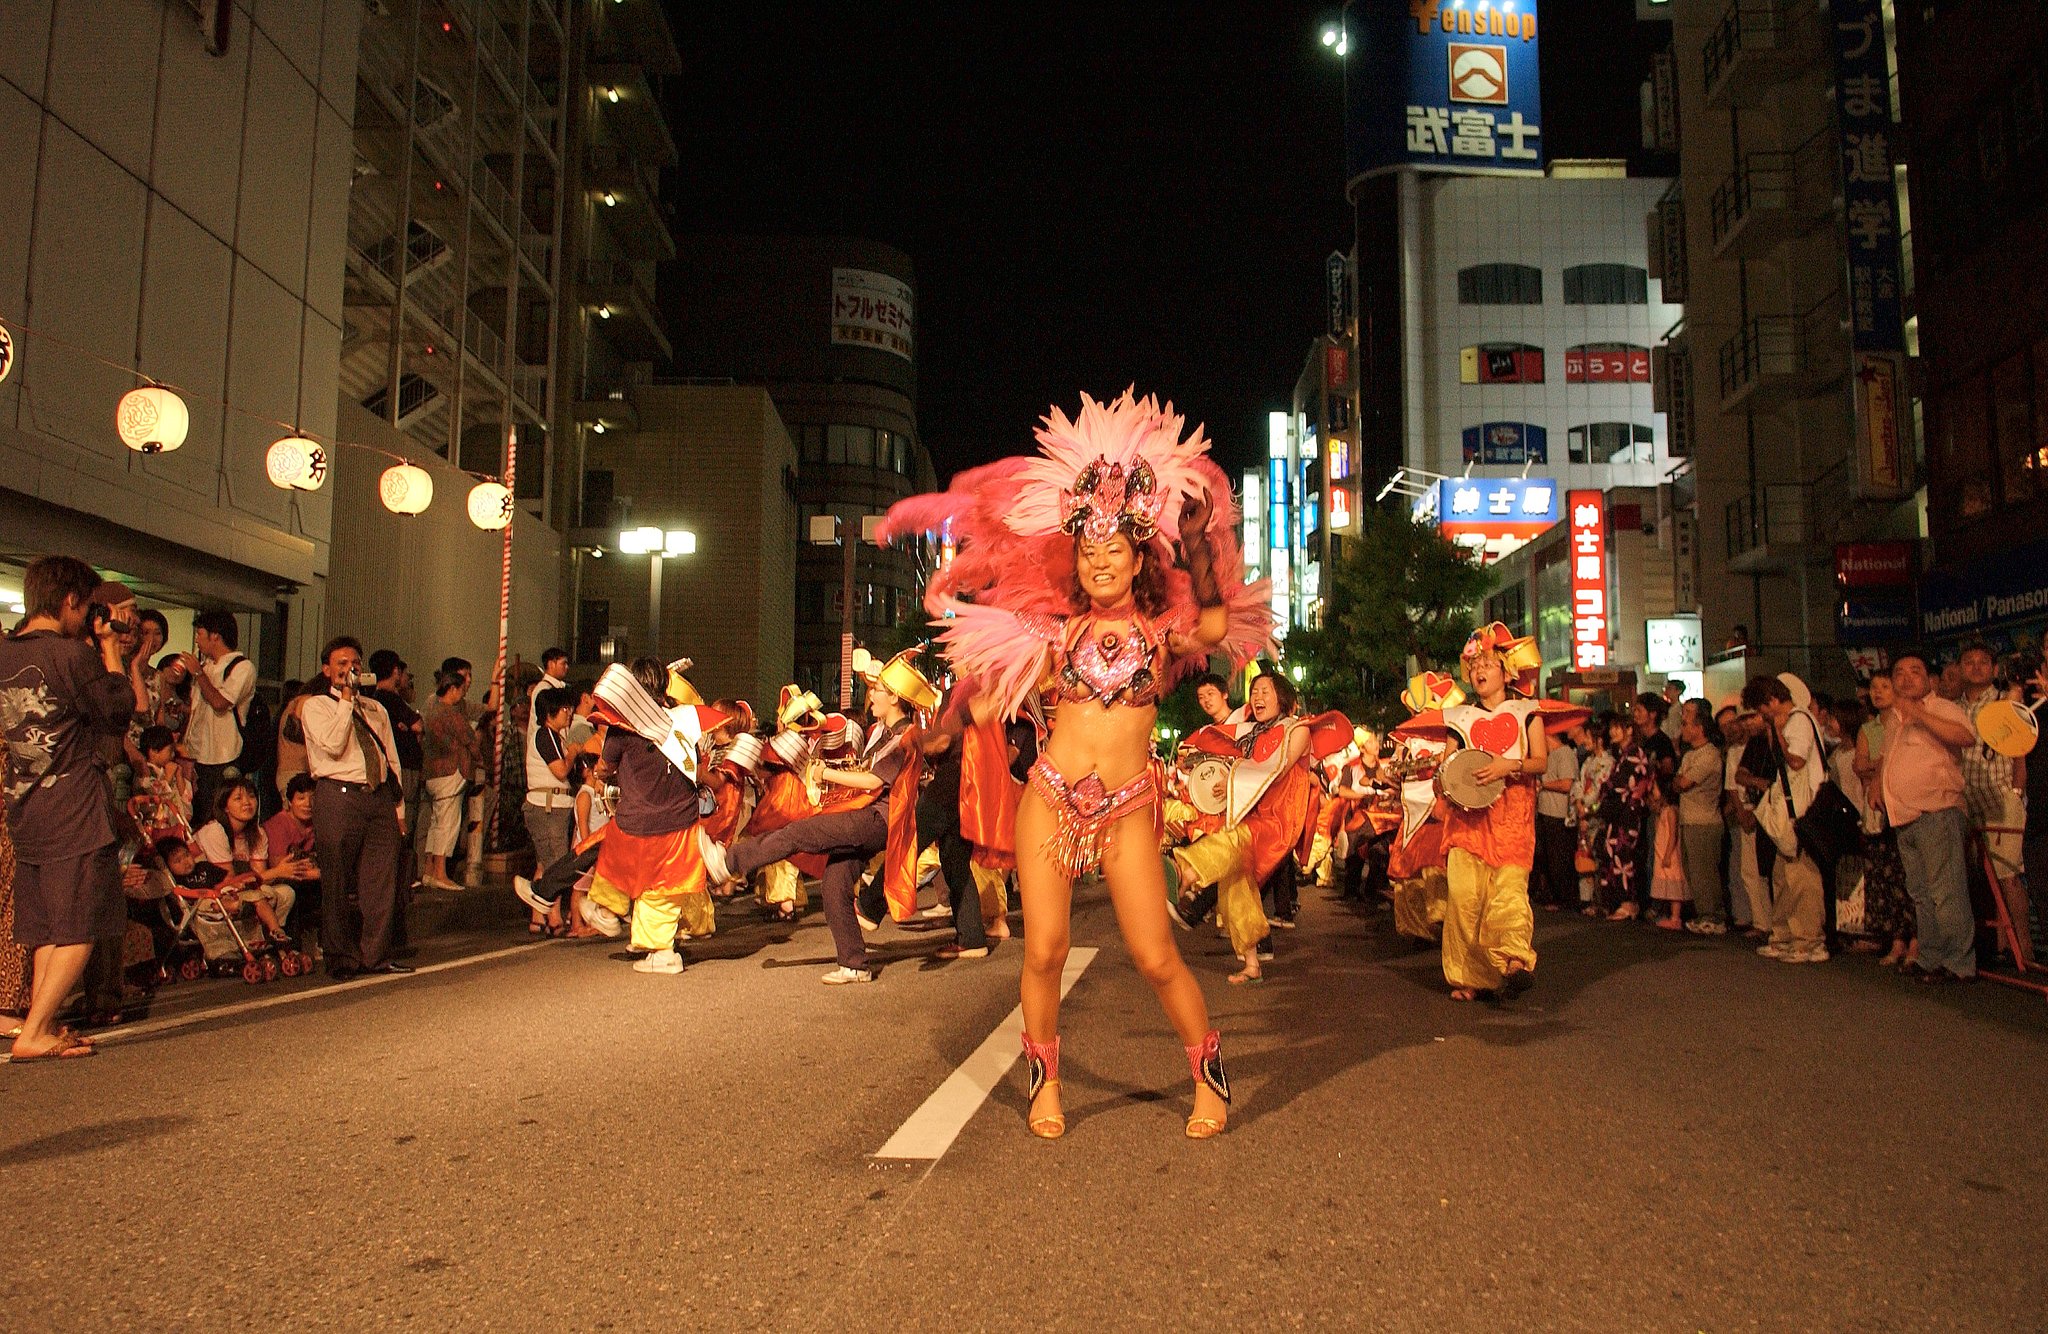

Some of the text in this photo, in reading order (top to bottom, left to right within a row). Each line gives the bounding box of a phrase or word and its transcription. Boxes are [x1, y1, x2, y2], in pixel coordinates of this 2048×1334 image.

[1406, 105, 1540, 160] 武富士
[1838, 0, 1892, 249] づま進学
[1841, 557, 1906, 571] National
[1575, 590, 1606, 668] コナカ
[1843, 615, 1909, 627] Panasonic
